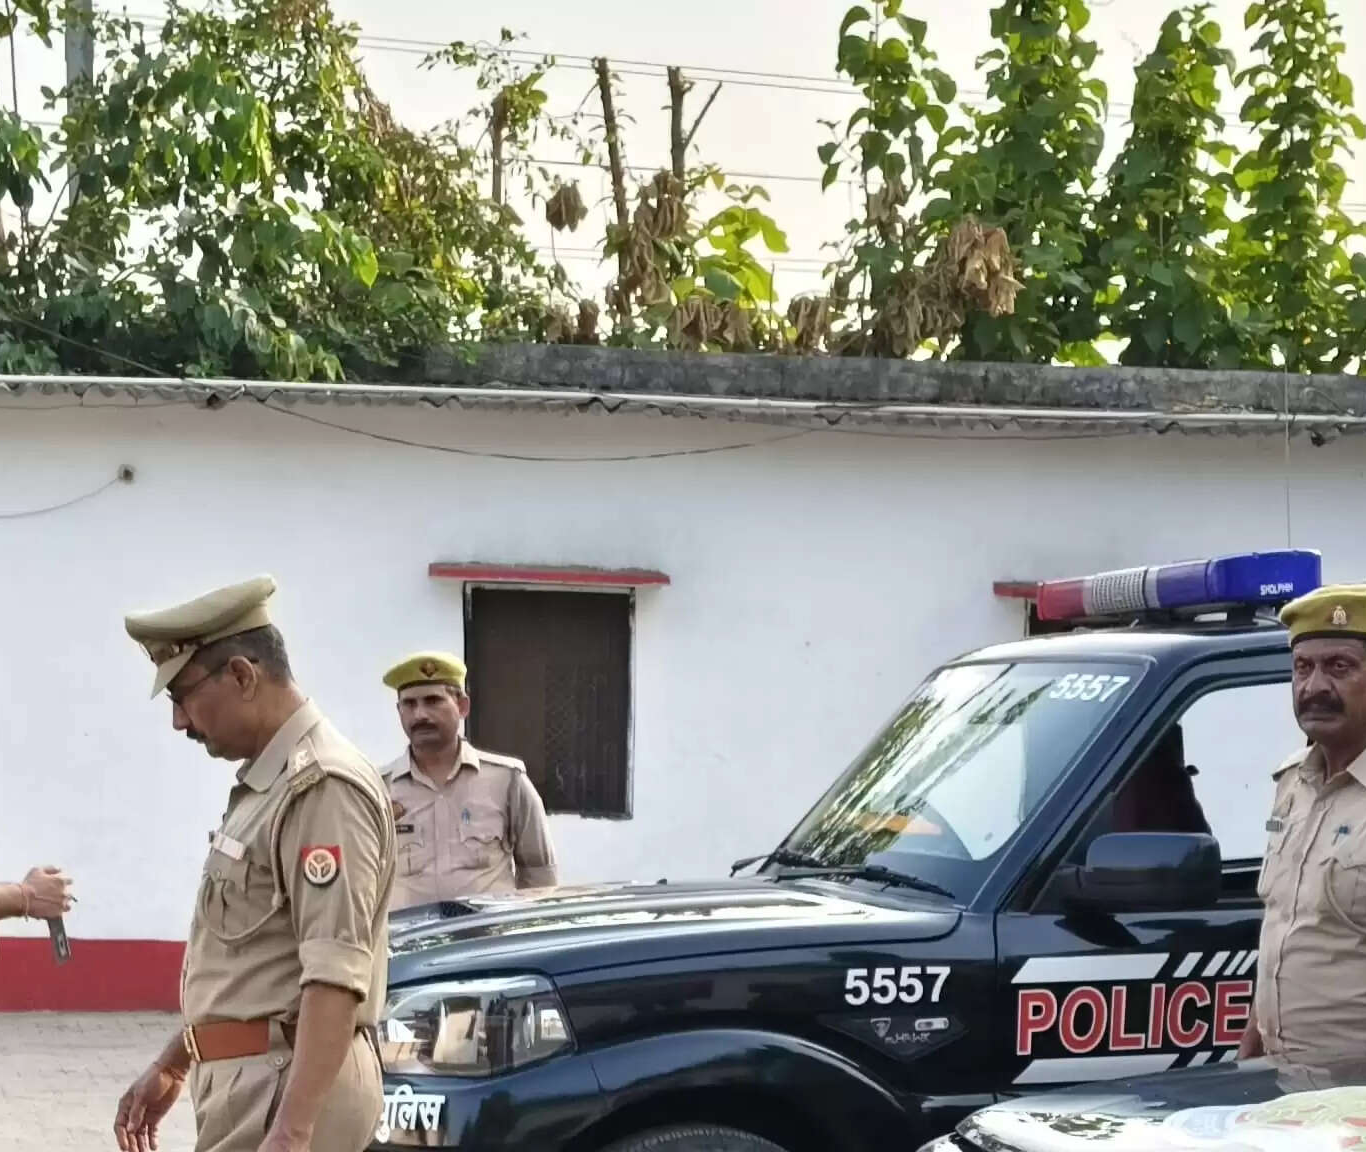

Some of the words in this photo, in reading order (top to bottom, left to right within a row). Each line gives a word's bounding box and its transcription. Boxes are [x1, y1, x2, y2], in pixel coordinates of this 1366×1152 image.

[1049, 672, 1132, 703] 5557
[844, 965, 951, 1006] 5557
[1016, 980, 1254, 1056] POLICE
